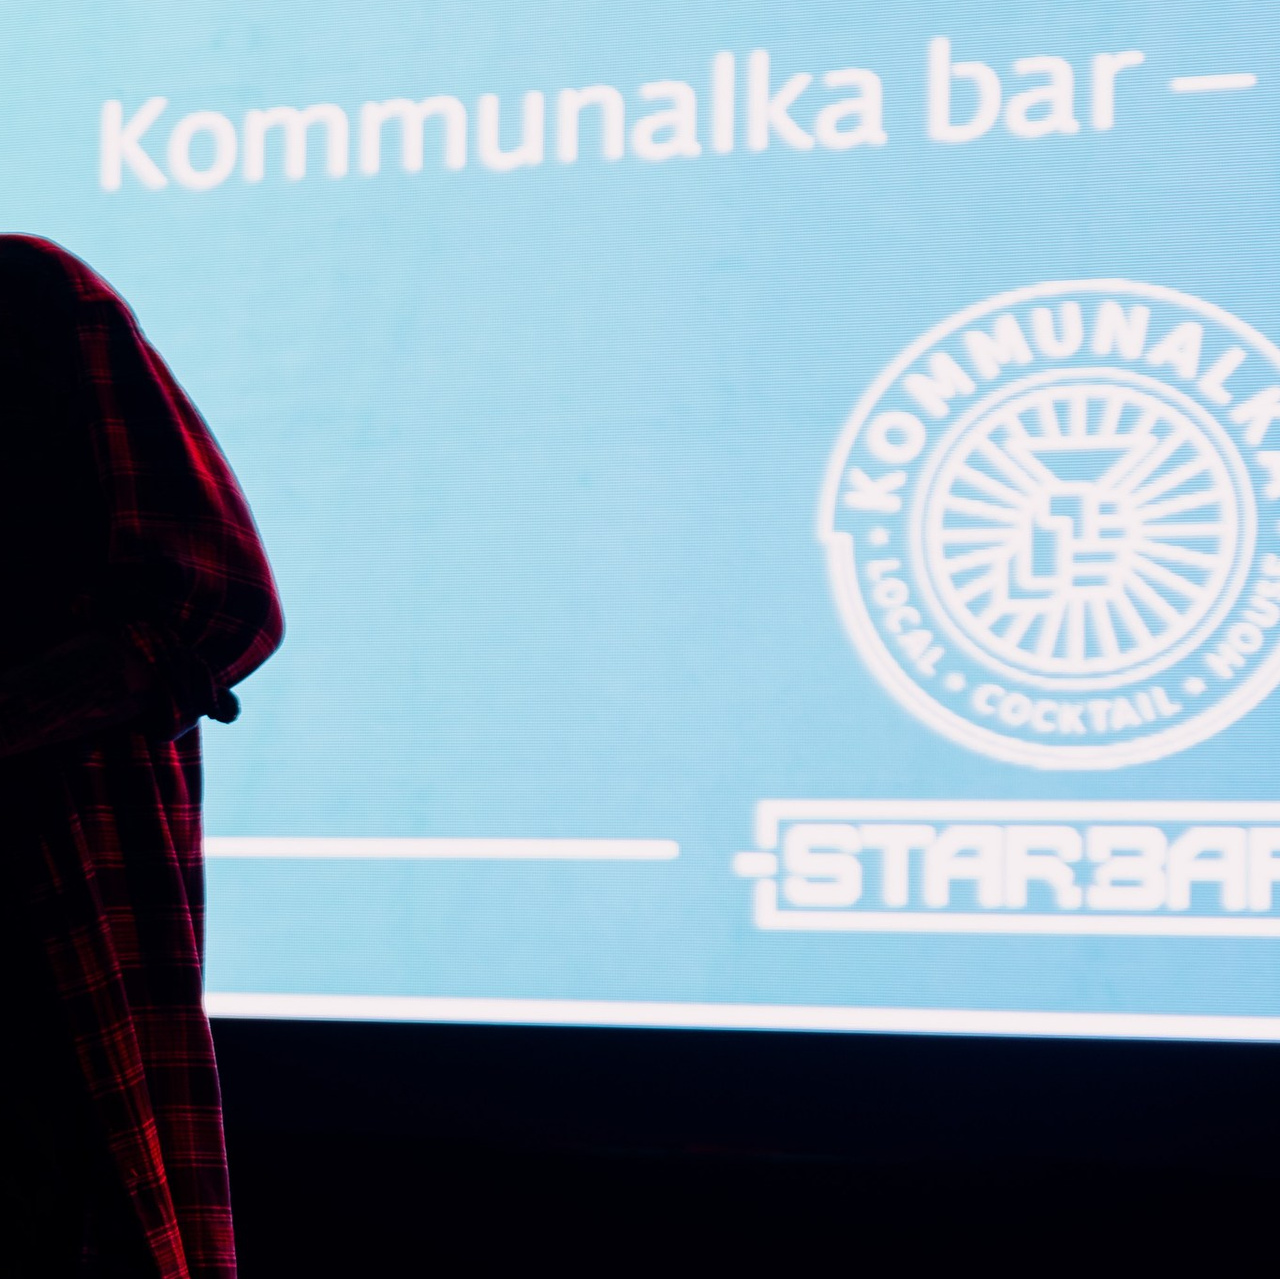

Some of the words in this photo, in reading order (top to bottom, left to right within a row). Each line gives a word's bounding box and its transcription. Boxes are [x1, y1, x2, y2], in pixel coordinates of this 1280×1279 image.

[98, 48, 889, 193] Kommunalka
[926, 34, 1147, 145] bar
[866, 558, 944, 677] LOCAL
[973, 683, 1183, 735] COCKTAIL
